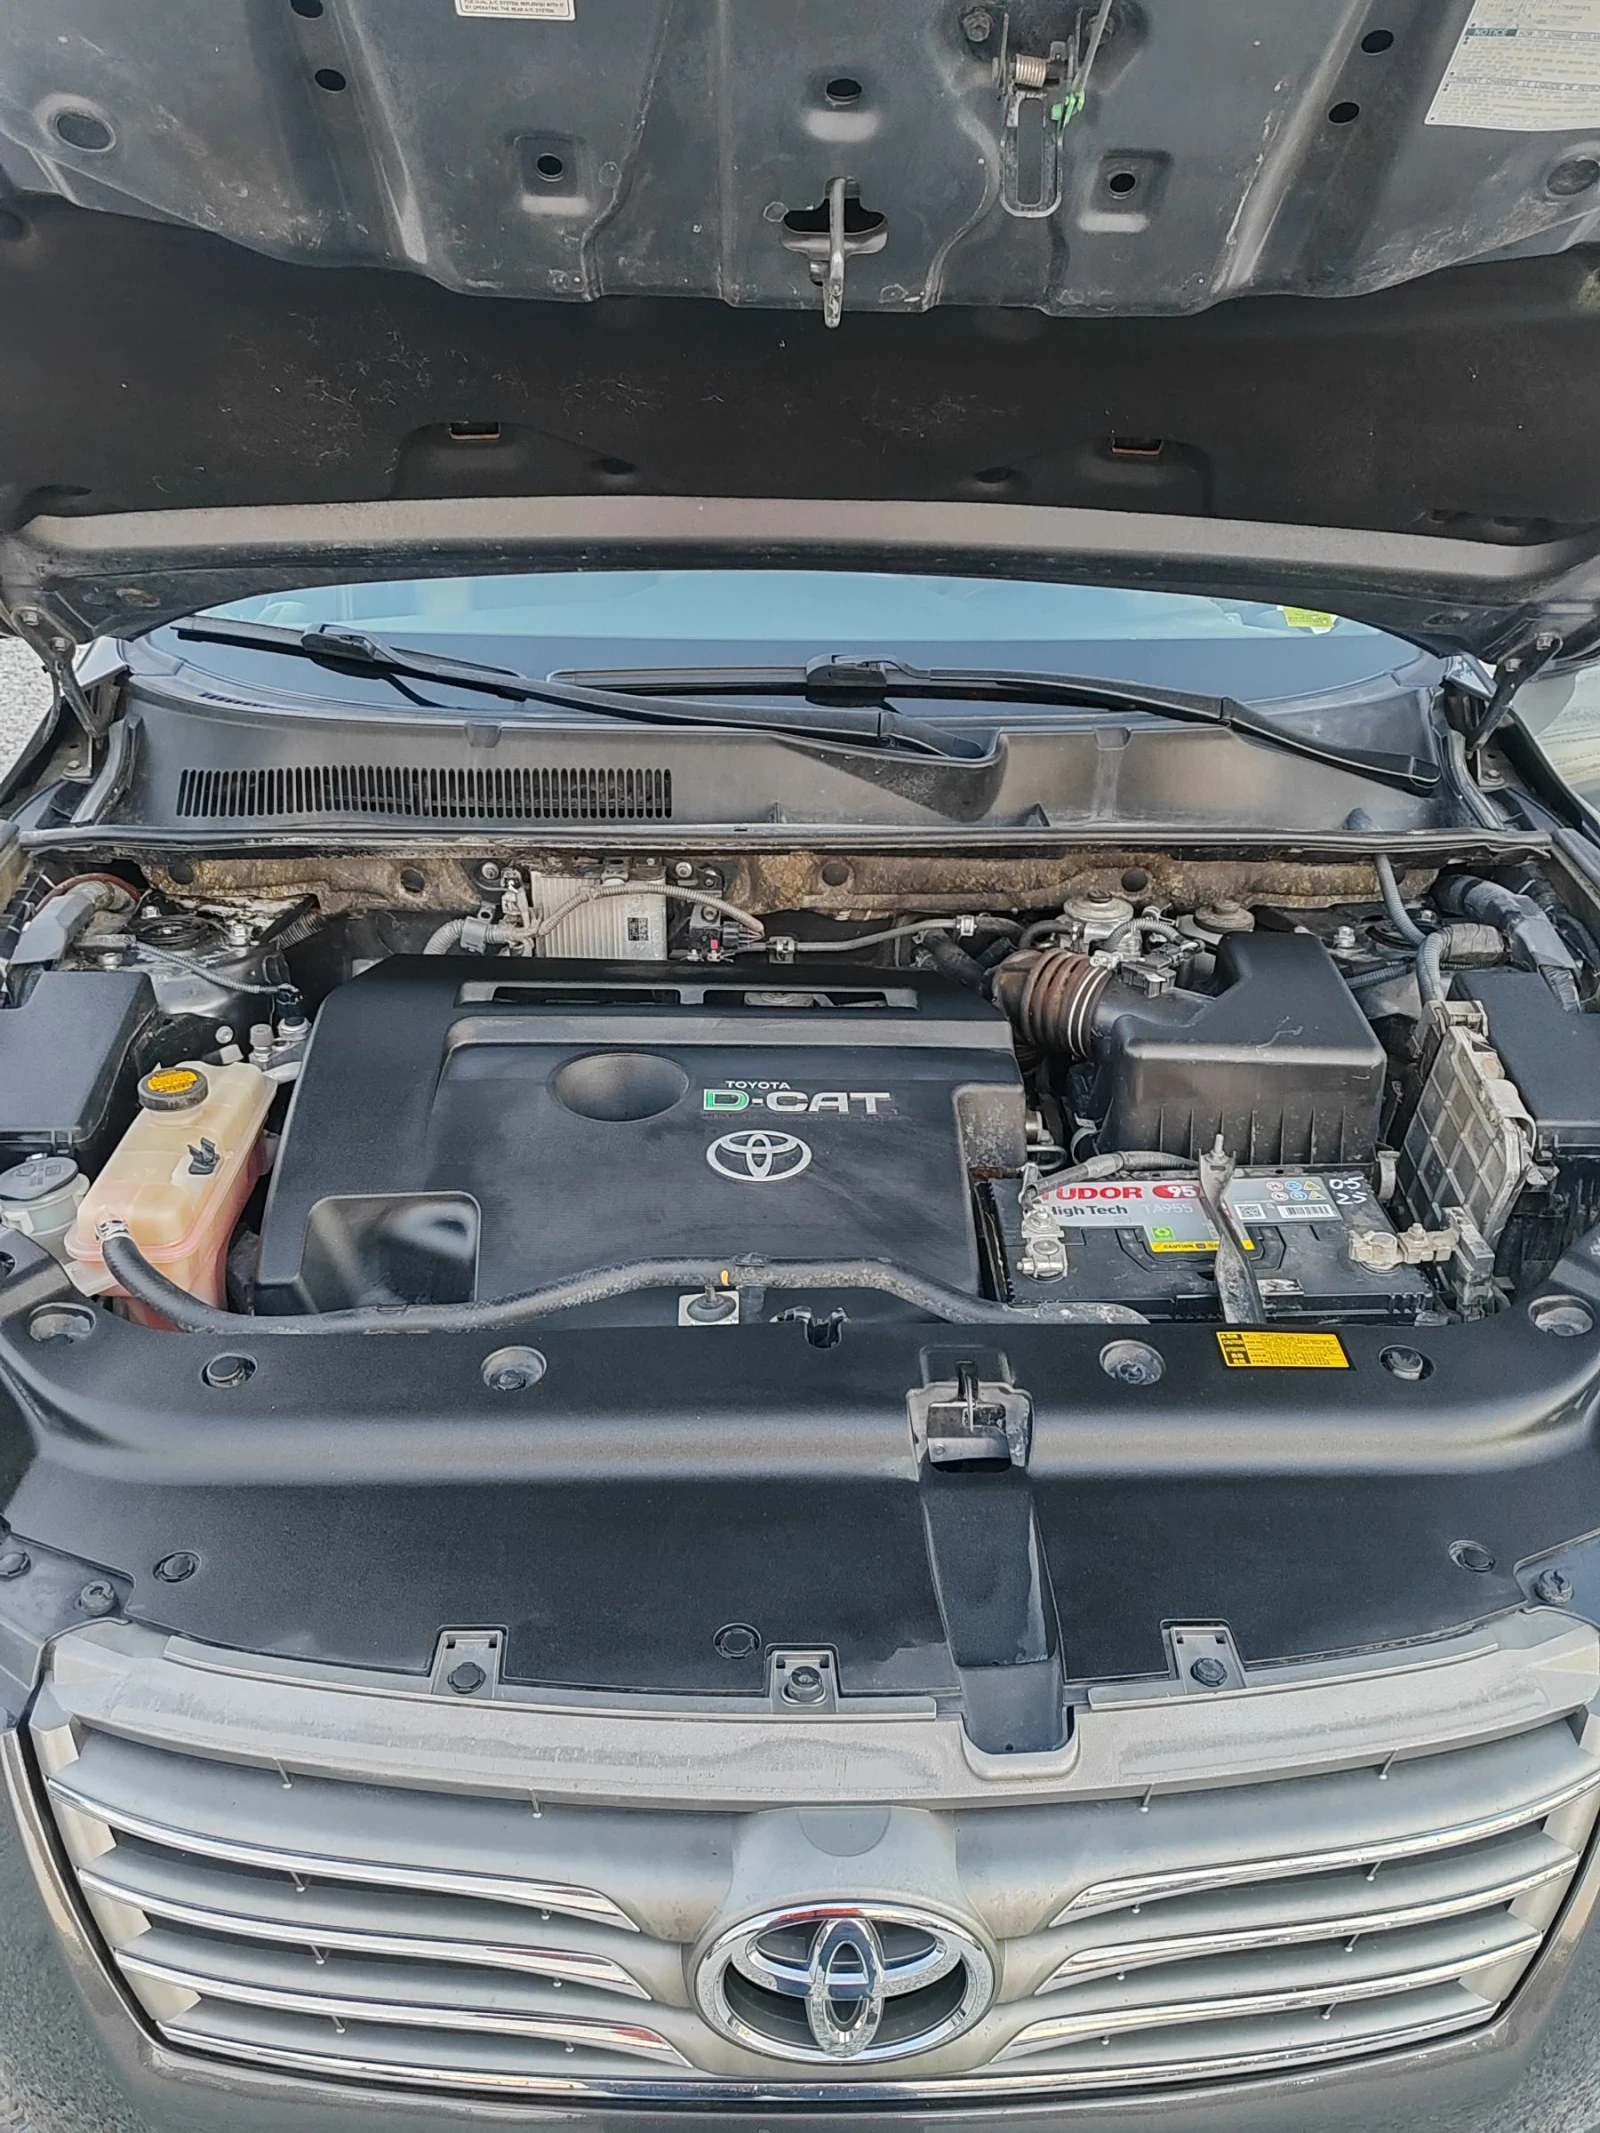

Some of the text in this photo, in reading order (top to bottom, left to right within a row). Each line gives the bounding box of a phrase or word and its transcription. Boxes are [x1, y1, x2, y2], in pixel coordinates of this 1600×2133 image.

[725, 1080, 790, 1090] TOYOTA
[703, 1088, 892, 1115] D-CAT
[1167, 1184, 1197, 1198] 95
[1086, 1205, 1128, 1215] Tech
[1142, 1203, 1194, 1214] TA955
